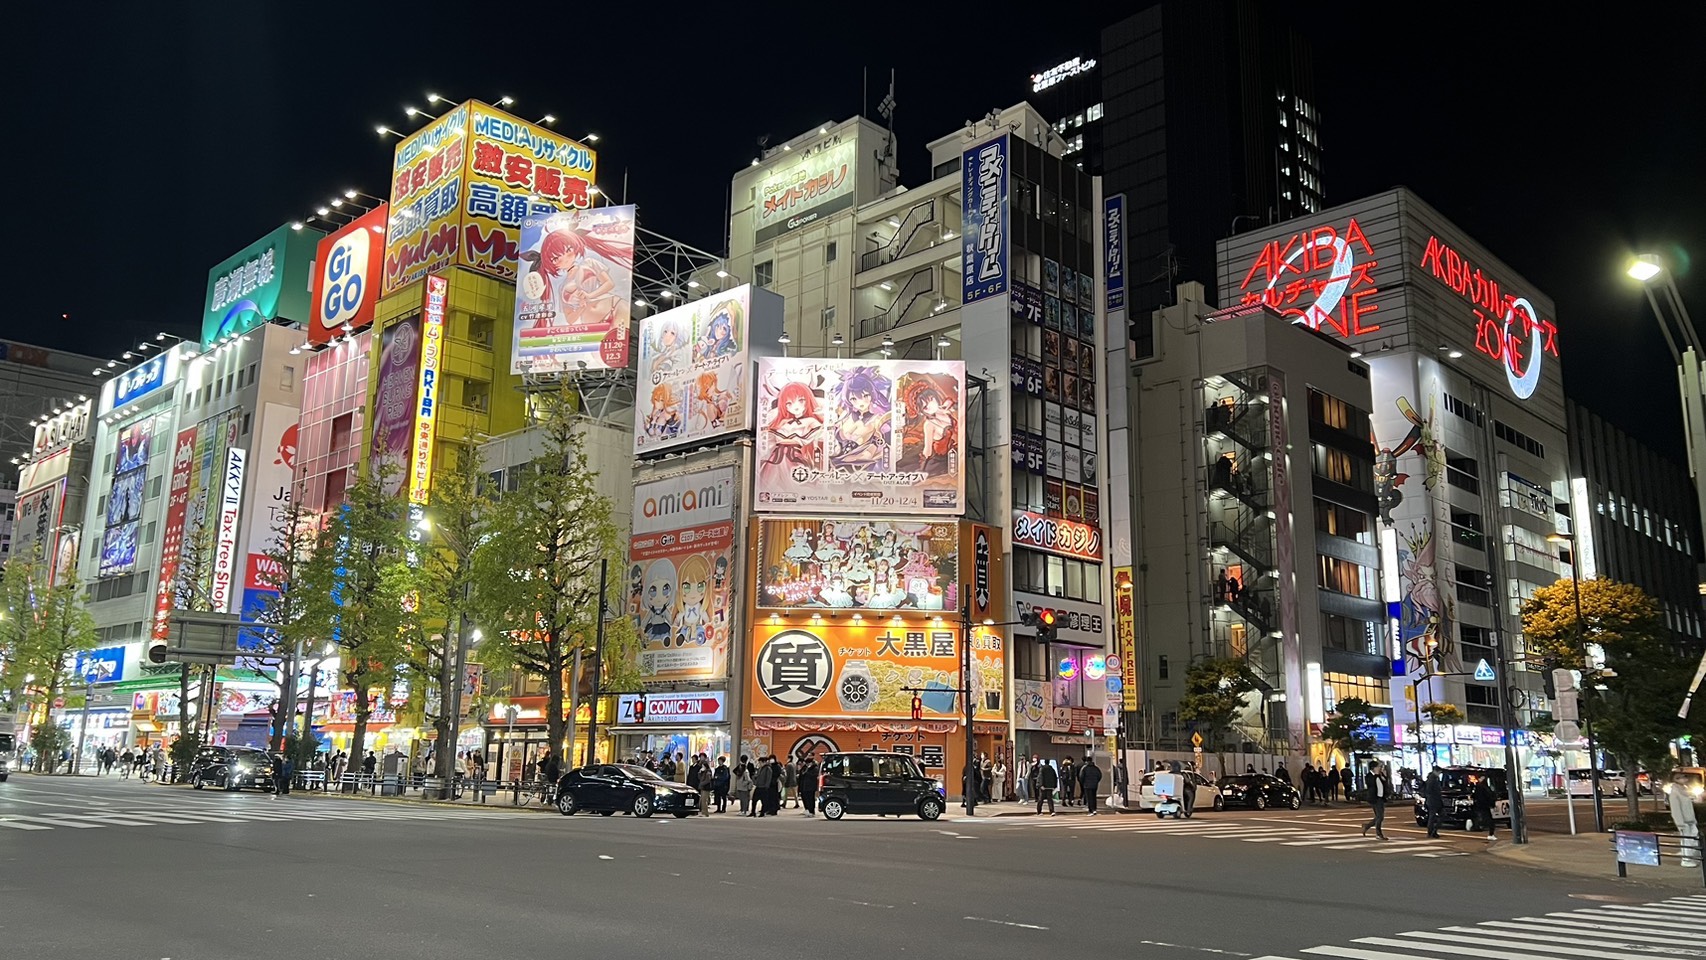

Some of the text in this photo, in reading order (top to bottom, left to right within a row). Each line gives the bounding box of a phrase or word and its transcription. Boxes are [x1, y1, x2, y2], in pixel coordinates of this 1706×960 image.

[396, 107, 467, 170] MEDIAリサイクル
[474, 116, 593, 172] MEDIAリサイクル
[395, 141, 463, 199] 激安販売
[474, 141, 591, 209] 激安販売
[763, 163, 848, 219] メイドカジノ
[391, 178, 459, 242] 高額買取
[386, 223, 457, 290] Mulan
[966, 244, 974, 286] 秋葉原店
[1240, 218, 1374, 290] AKIBA
[967, 283, 1002, 300] 5F・6F
[1240, 260, 1378, 307] カルチャーズ
[1027, 303, 1042, 322] 7F
[1280, 288, 1380, 338] ONE
[1473, 309, 1526, 378] ZONE
[1027, 376, 1042, 395] 6F
[172, 471, 190, 492] GAME
[228, 451, 243, 493] AKKY
[1028, 451, 1043, 470] 5F
[643, 482, 722, 518] amiami
[217, 508, 237, 569] Tax-free
[661, 534, 675, 547] Gift
[1015, 514, 1100, 555] メイドカジノ
[838, 631, 956, 658] チケット 大黒屋
[1125, 620, 1133, 647] TAX
[767, 642, 824, 698] 質
[1108, 658, 1118, 667] 40
[1126, 651, 1135, 686] FREE
[649, 700, 702, 714] COMIC ZIN
[881, 733, 926, 742] チケット
